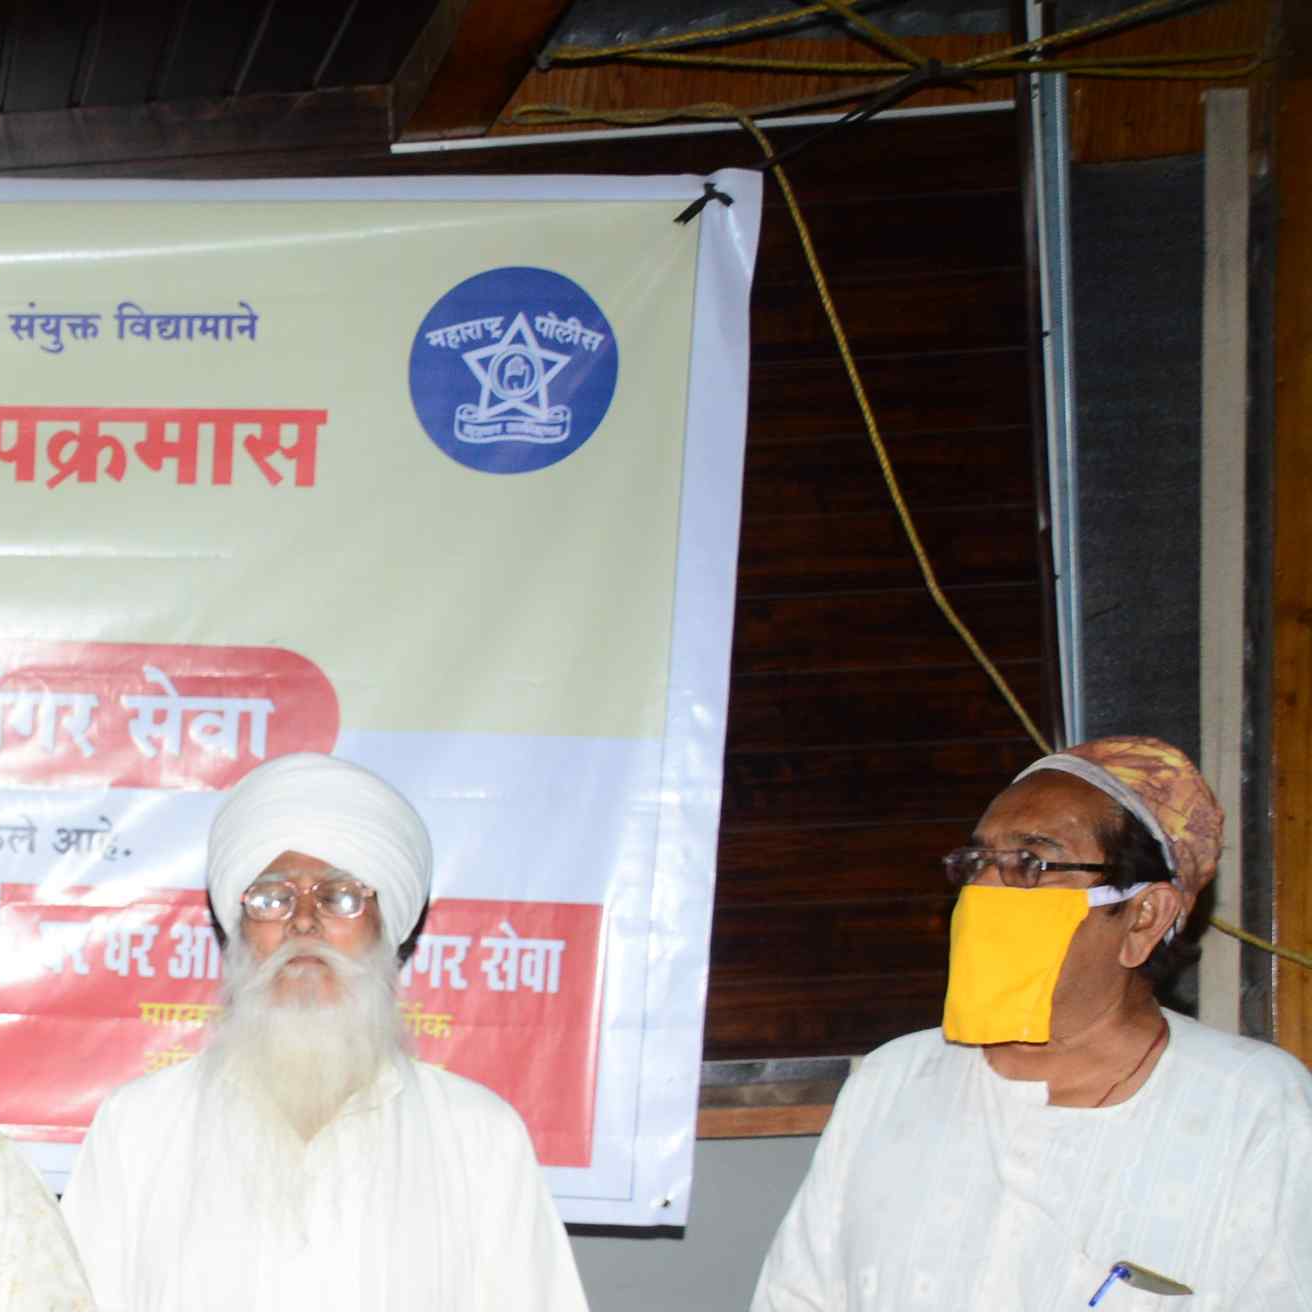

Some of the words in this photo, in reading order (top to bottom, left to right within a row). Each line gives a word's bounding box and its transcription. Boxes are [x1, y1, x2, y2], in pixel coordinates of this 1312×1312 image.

[8, 301, 102, 354] संयुक्त
[113, 301, 259, 341] विद्यामाने
[534, 311, 605, 352] पोलीस
[120, 664, 275, 760] सेवा
[480, 918, 566, 993] सेवा
